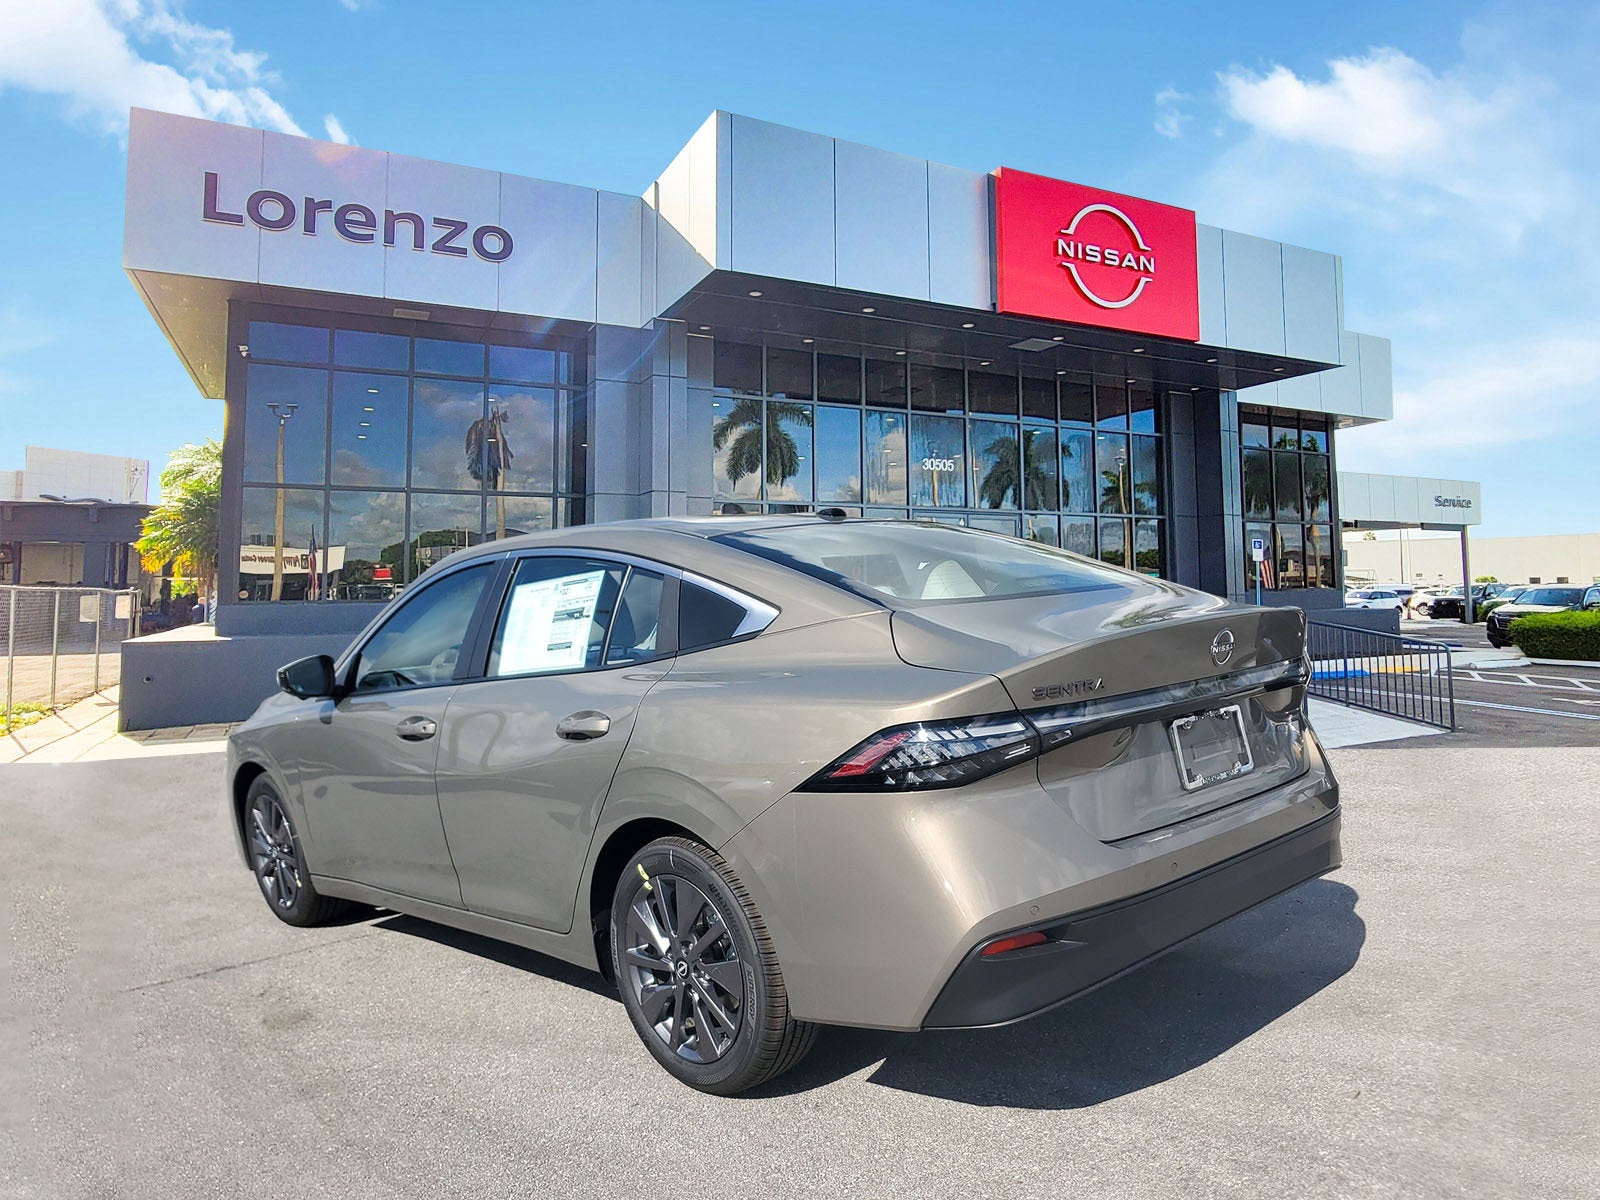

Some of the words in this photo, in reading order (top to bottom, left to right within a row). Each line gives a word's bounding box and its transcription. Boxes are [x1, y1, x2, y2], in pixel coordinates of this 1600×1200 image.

[202, 171, 514, 263] Lorenzo
[1057, 238, 1156, 274] NISSAN
[922, 457, 955, 472] 30505
[1434, 495, 1472, 509] Service
[1032, 678, 1105, 701] SENTRA
